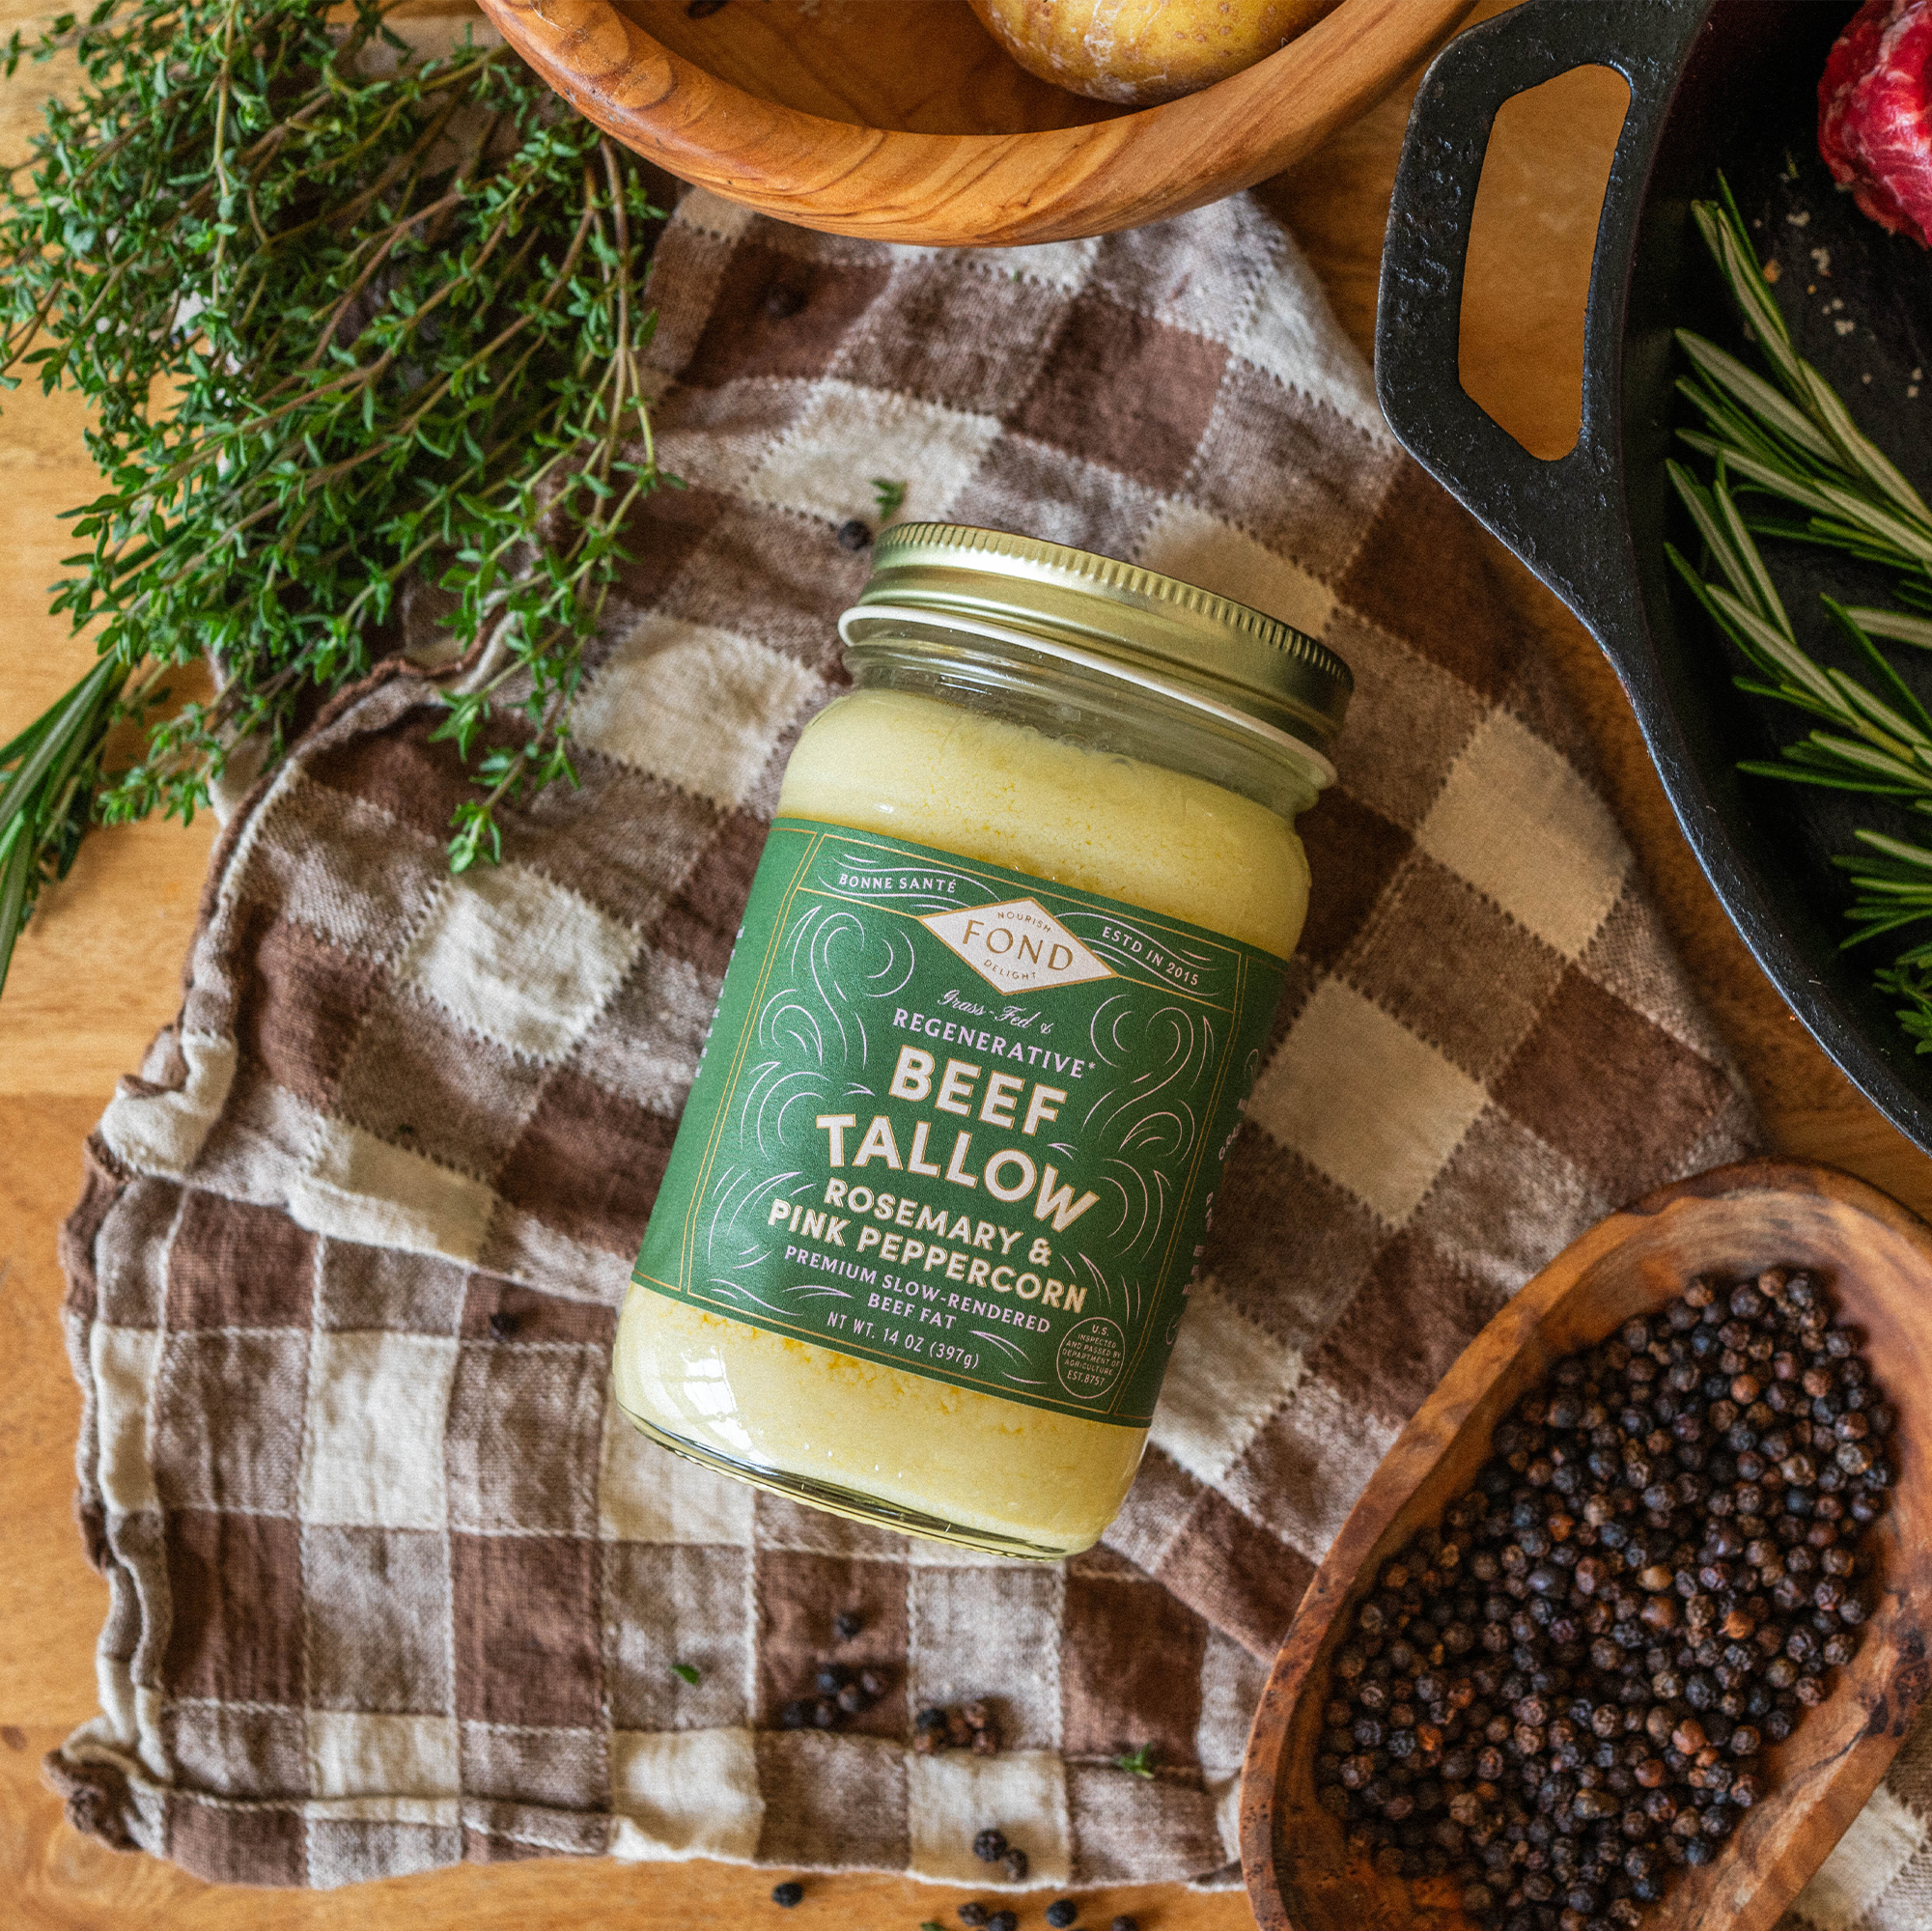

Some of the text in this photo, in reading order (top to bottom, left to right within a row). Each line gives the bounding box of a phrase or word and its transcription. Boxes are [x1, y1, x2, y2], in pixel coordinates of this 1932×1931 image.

[838, 873, 957, 893] BONNE SANTÉ
[997, 910, 1051, 934] NOURISH
[962, 919, 1074, 971] FOND
[1102, 926, 1199, 986] ESTD IN 2015
[983, 959, 1037, 980] DELIGHT
[1040, 1021, 1054, 1035] &
[888, 1044, 1068, 1136] BEEF
[815, 1113, 1101, 1233] TALLOW
[824, 1177, 1051, 1267] ROSEMARY &
[767, 1198, 1087, 1313] PINK PEPPERCORN
[784, 1245, 1051, 1333] PREMIUM SLOW-RENDERED
[867, 1292, 957, 1329] BEEF FAT
[826, 1311, 980, 1370] NT WT. 14 OZ (397g)
[1078, 1333, 1117, 1349] INSPECTED
[1091, 1324, 1109, 1336] U.S.
[1061, 1348, 1110, 1365] DEPARTMENT
[1065, 1339, 1082, 1350] AND
[1083, 1344, 1111, 1357] PASSED
[1064, 1358, 1113, 1376] AGRICULTURE
